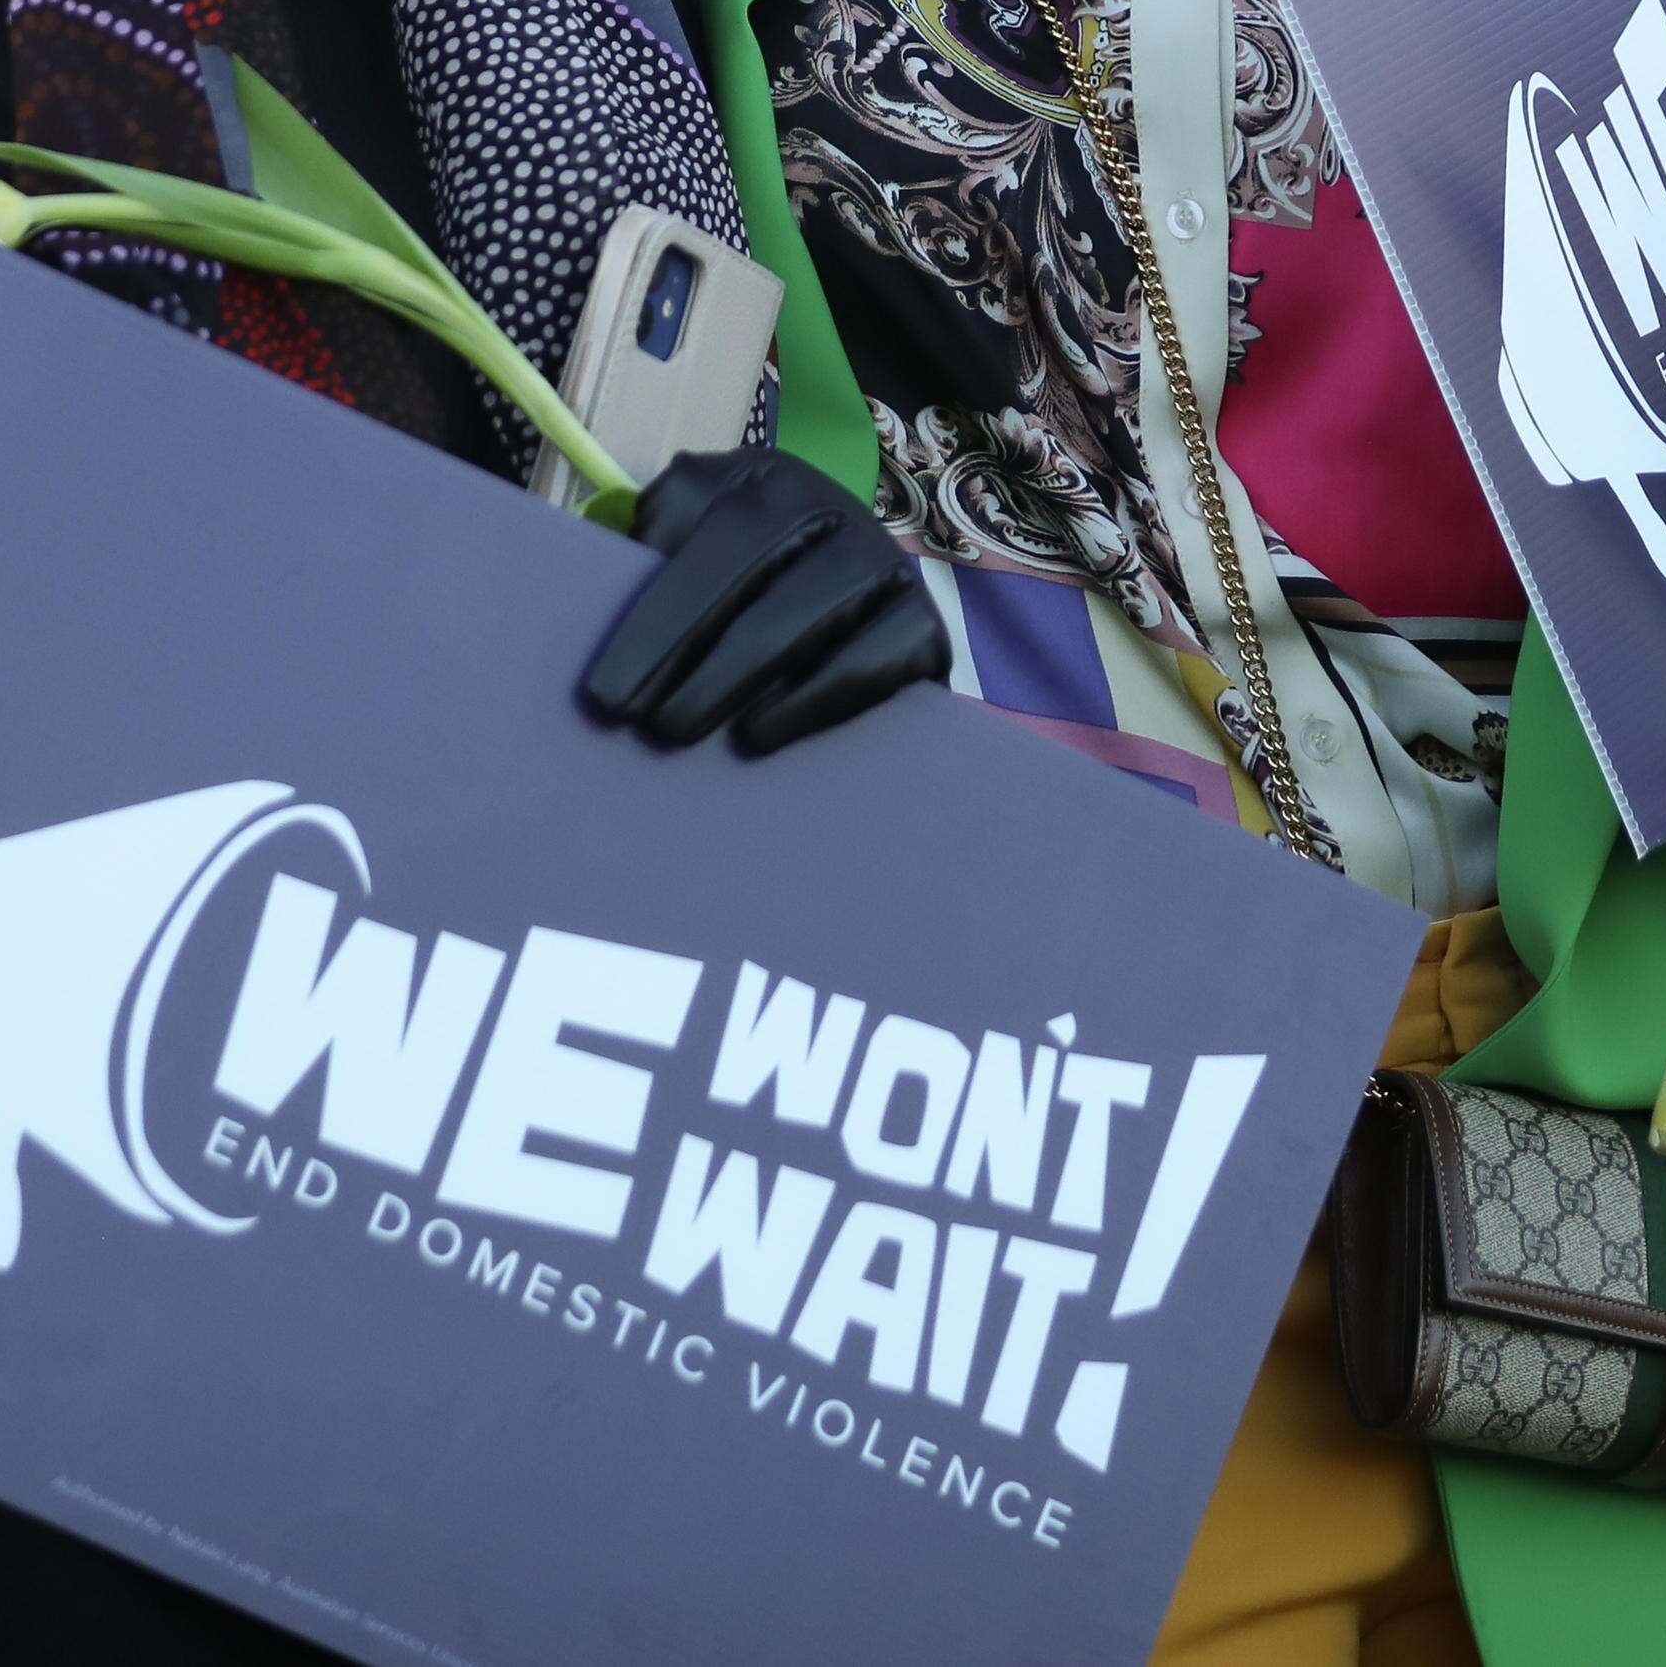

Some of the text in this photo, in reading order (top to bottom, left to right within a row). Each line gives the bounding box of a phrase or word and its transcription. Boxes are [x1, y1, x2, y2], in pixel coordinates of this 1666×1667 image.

[211, 870, 1154, 1242] WE WON'T
[202, 1114, 1075, 1548] END DOMESTIC VIOLENCE
